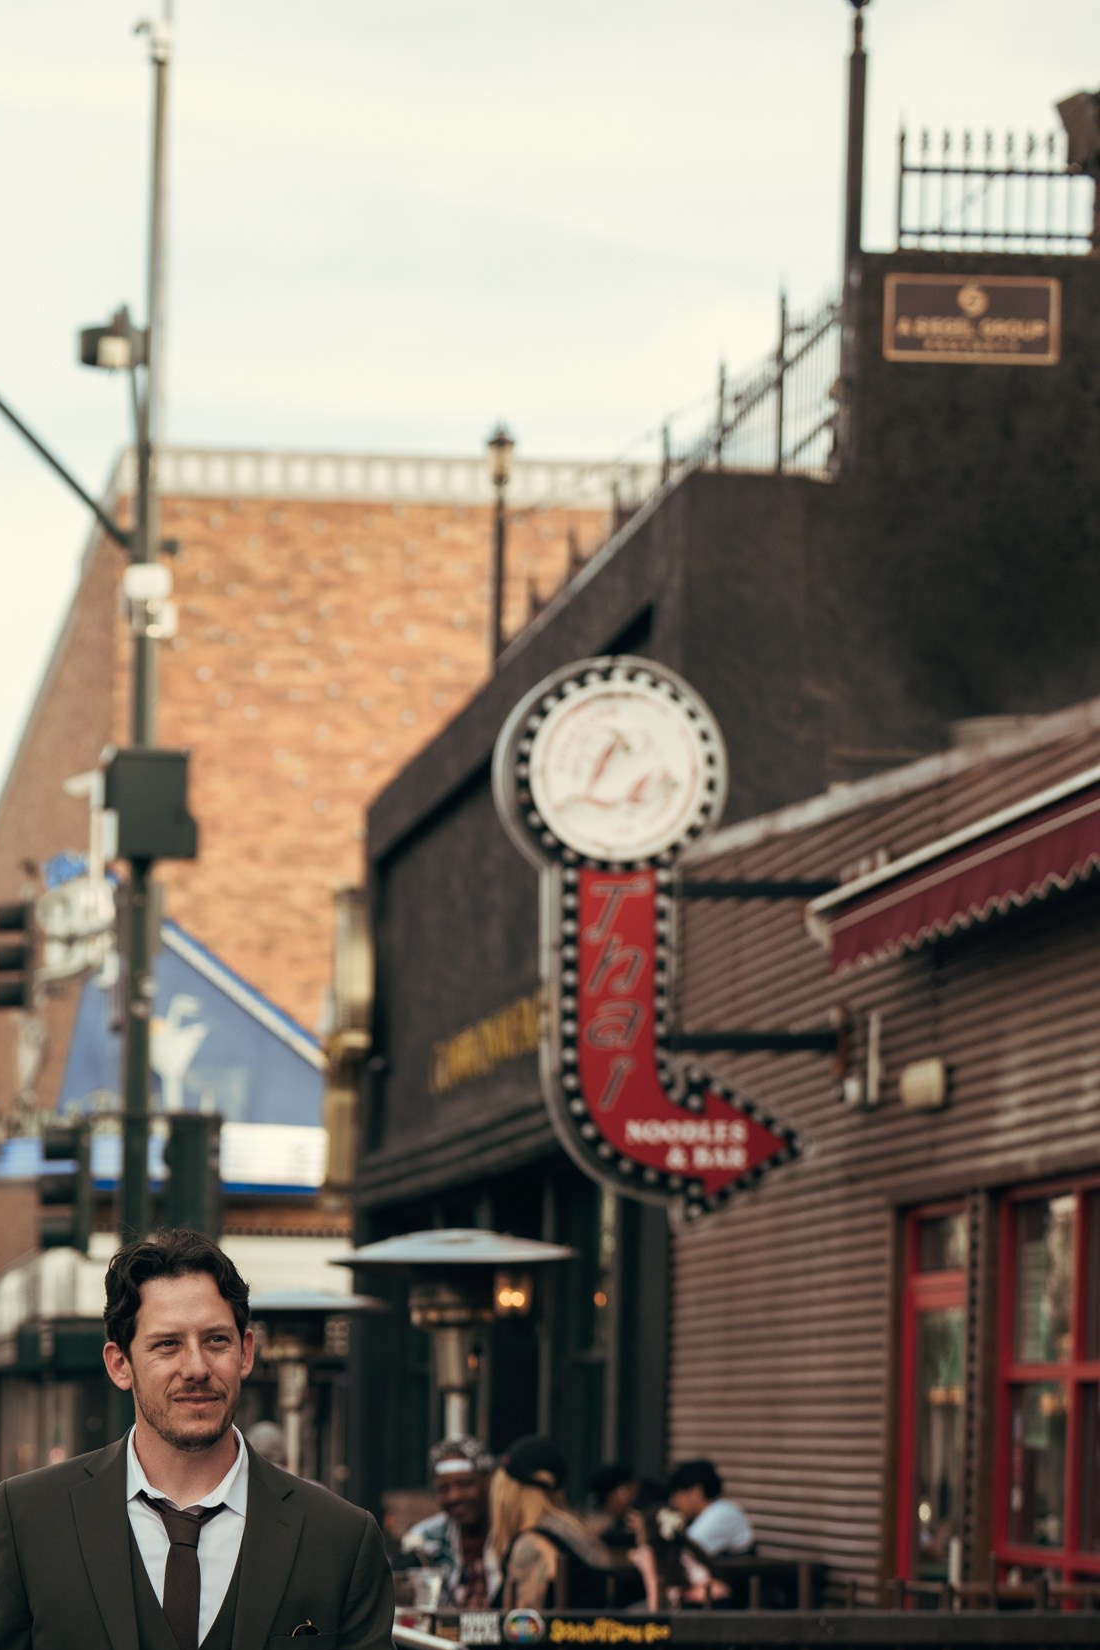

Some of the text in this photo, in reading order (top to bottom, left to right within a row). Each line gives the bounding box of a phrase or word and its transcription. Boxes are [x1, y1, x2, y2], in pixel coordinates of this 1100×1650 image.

[898, 317, 910, 336] A
[979, 318, 1046, 340] GROUP
[625, 1119, 747, 1145] NOODLES
[666, 1145, 747, 1170] & BAR
